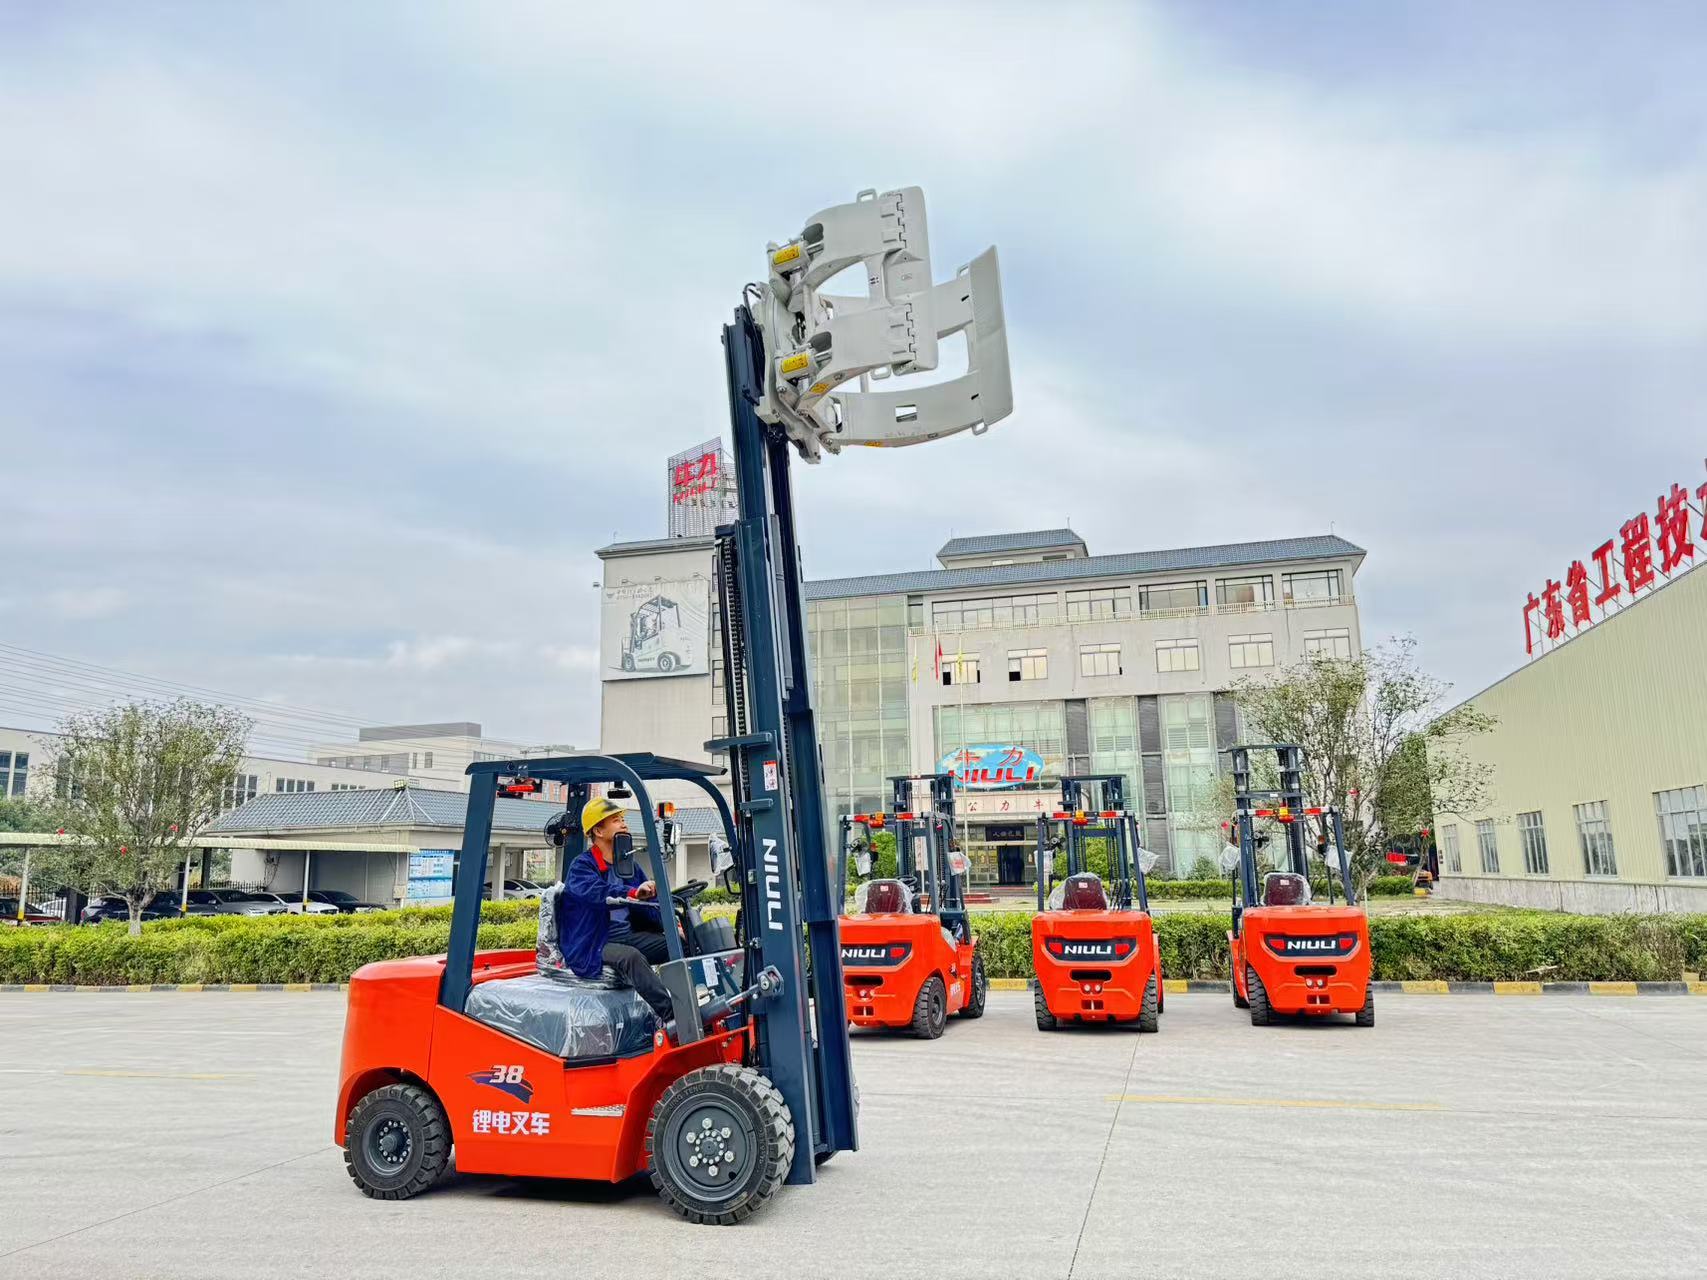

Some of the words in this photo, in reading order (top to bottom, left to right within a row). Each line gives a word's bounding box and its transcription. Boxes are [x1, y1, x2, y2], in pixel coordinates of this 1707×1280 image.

[954, 746, 1024, 767] 牛力
[947, 766, 1035, 784] NIULI
[762, 838, 784, 931] NIULI
[841, 948, 886, 958] NIULI
[1064, 945, 1112, 954] NIULI
[1287, 940, 1336, 950] NIULI
[489, 1064, 525, 1084] 38
[472, 1109, 550, 1136] 锂电叉车
